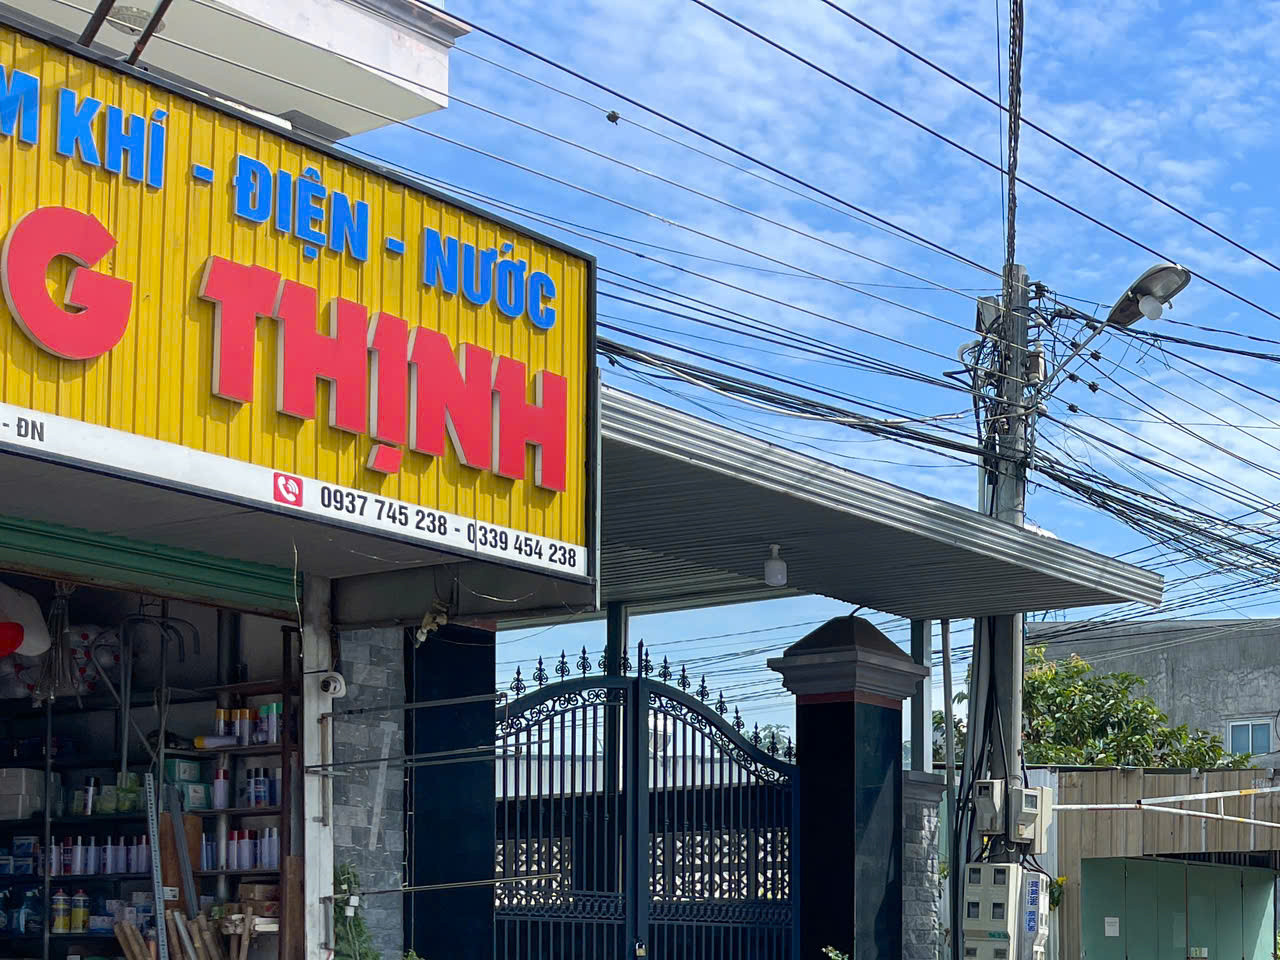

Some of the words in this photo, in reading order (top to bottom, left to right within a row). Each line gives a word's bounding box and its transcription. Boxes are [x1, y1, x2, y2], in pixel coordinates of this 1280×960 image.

[57, 88, 168, 190] KHÍ
[233, 154, 370, 263] ĐIỆN
[421, 226, 557, 331] NƯỚC
[16, 416, 45, 442] ĐN
[199, 254, 568, 493] THỊNH
[320, 485, 368, 517] 0937
[375, 498, 409, 527] 745
[415, 509, 448, 536] 238
[466, 522, 508, 552] 0339
[514, 535, 544, 560] 454
[548, 543, 577, 569] 238
